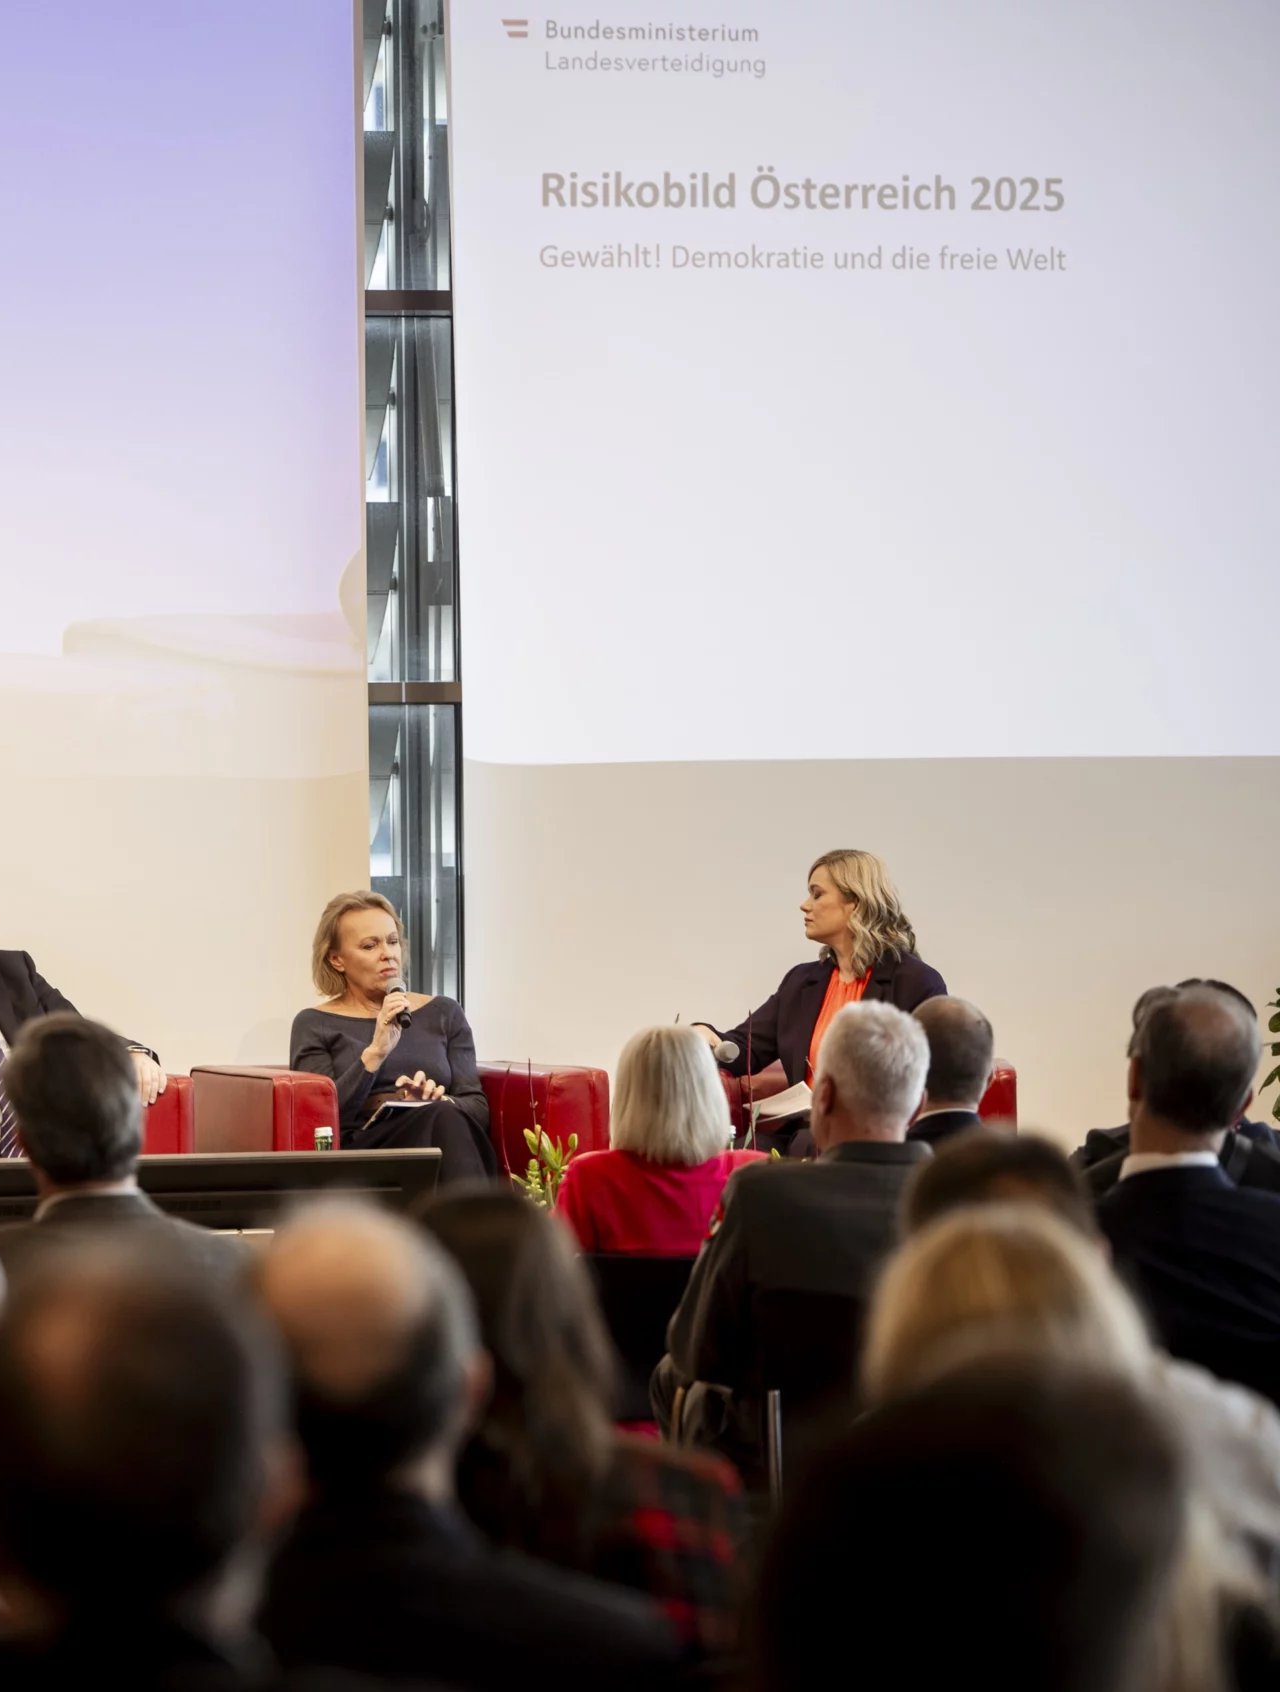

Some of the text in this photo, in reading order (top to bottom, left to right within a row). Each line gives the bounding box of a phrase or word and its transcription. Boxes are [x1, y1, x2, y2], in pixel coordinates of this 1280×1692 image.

[545, 19, 760, 43] Bundesministerium
[545, 49, 767, 79] Landesverteidigung
[541, 165, 1065, 213] Risikobild Österreich 2025
[539, 242, 1067, 272] Gewählt! Demokratie und die freie Welt
